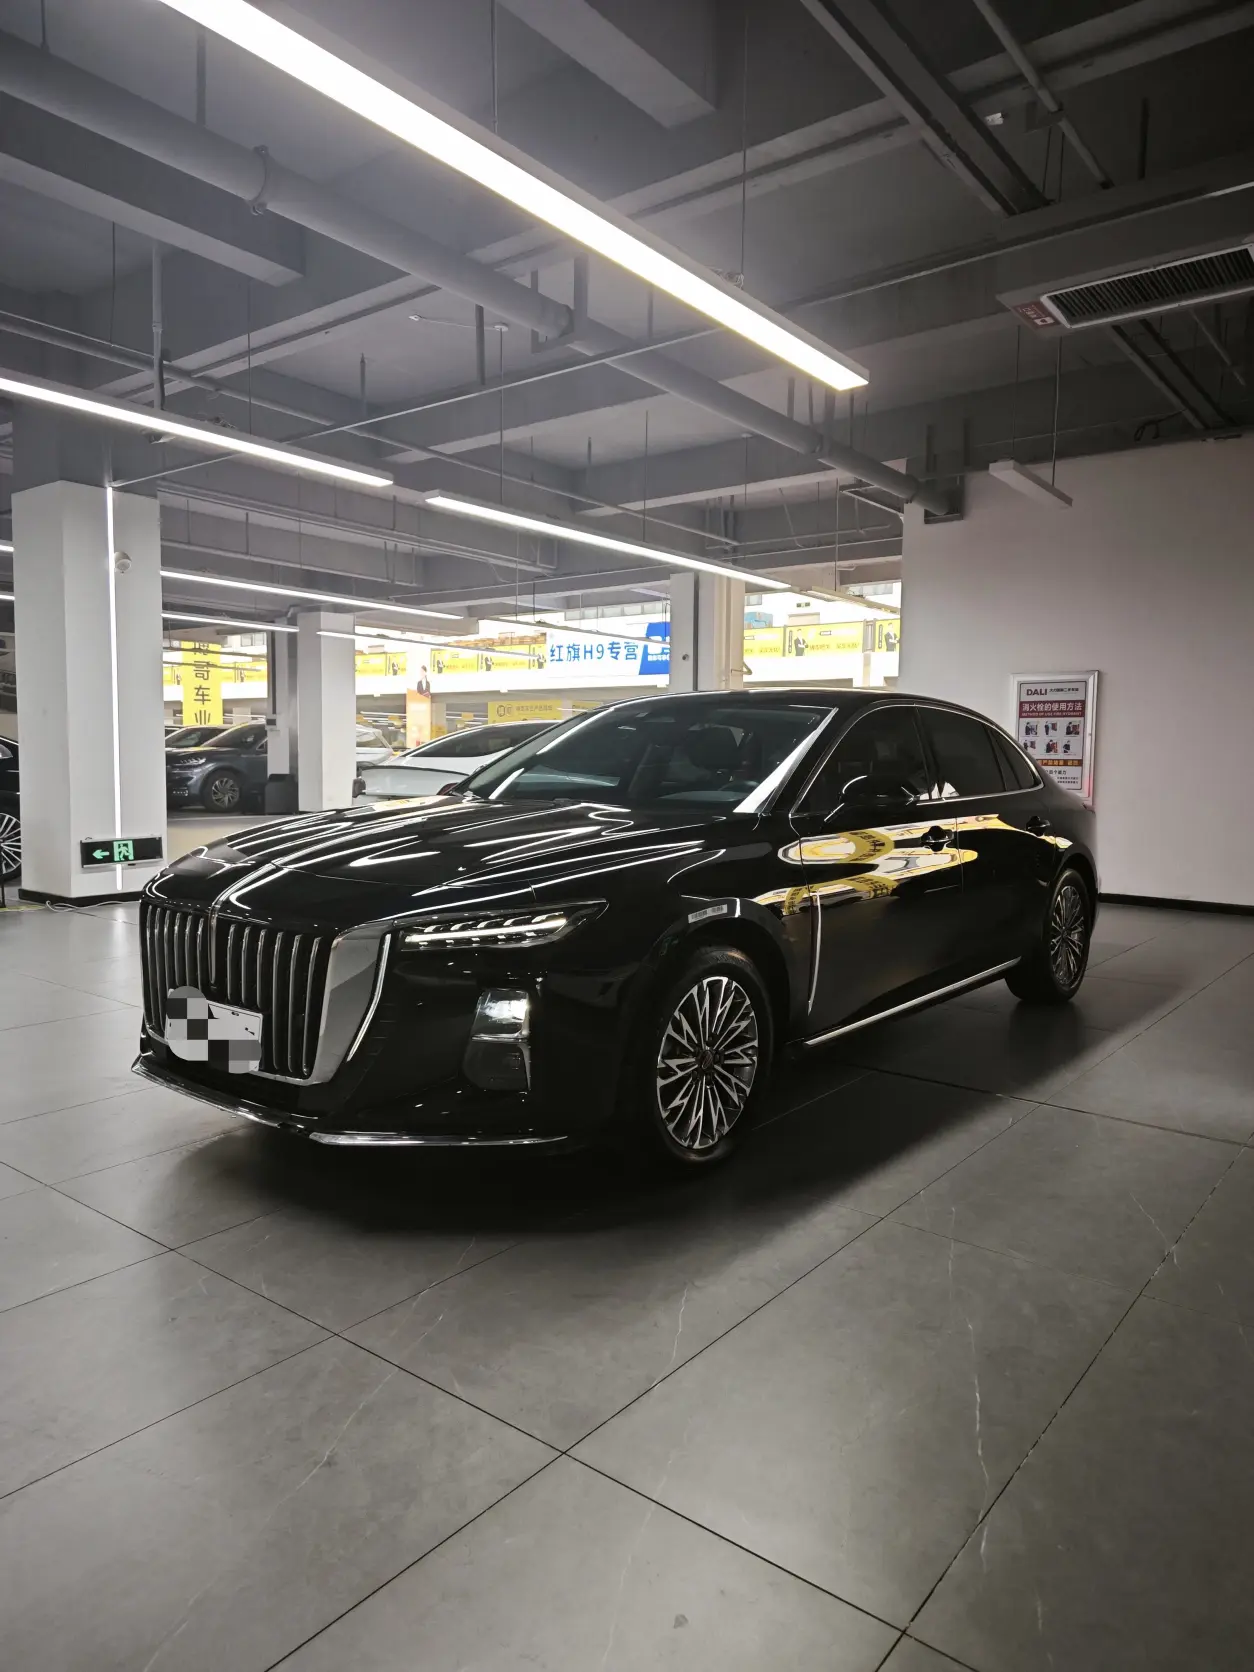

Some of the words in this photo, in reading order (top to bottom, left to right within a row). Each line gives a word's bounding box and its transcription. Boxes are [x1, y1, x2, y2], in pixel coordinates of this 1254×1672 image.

[549, 641, 638, 662] 红旗H9专营
[1026, 688, 1048, 696] DALI
[1022, 702, 1082, 711] 消火栓的使用方法
